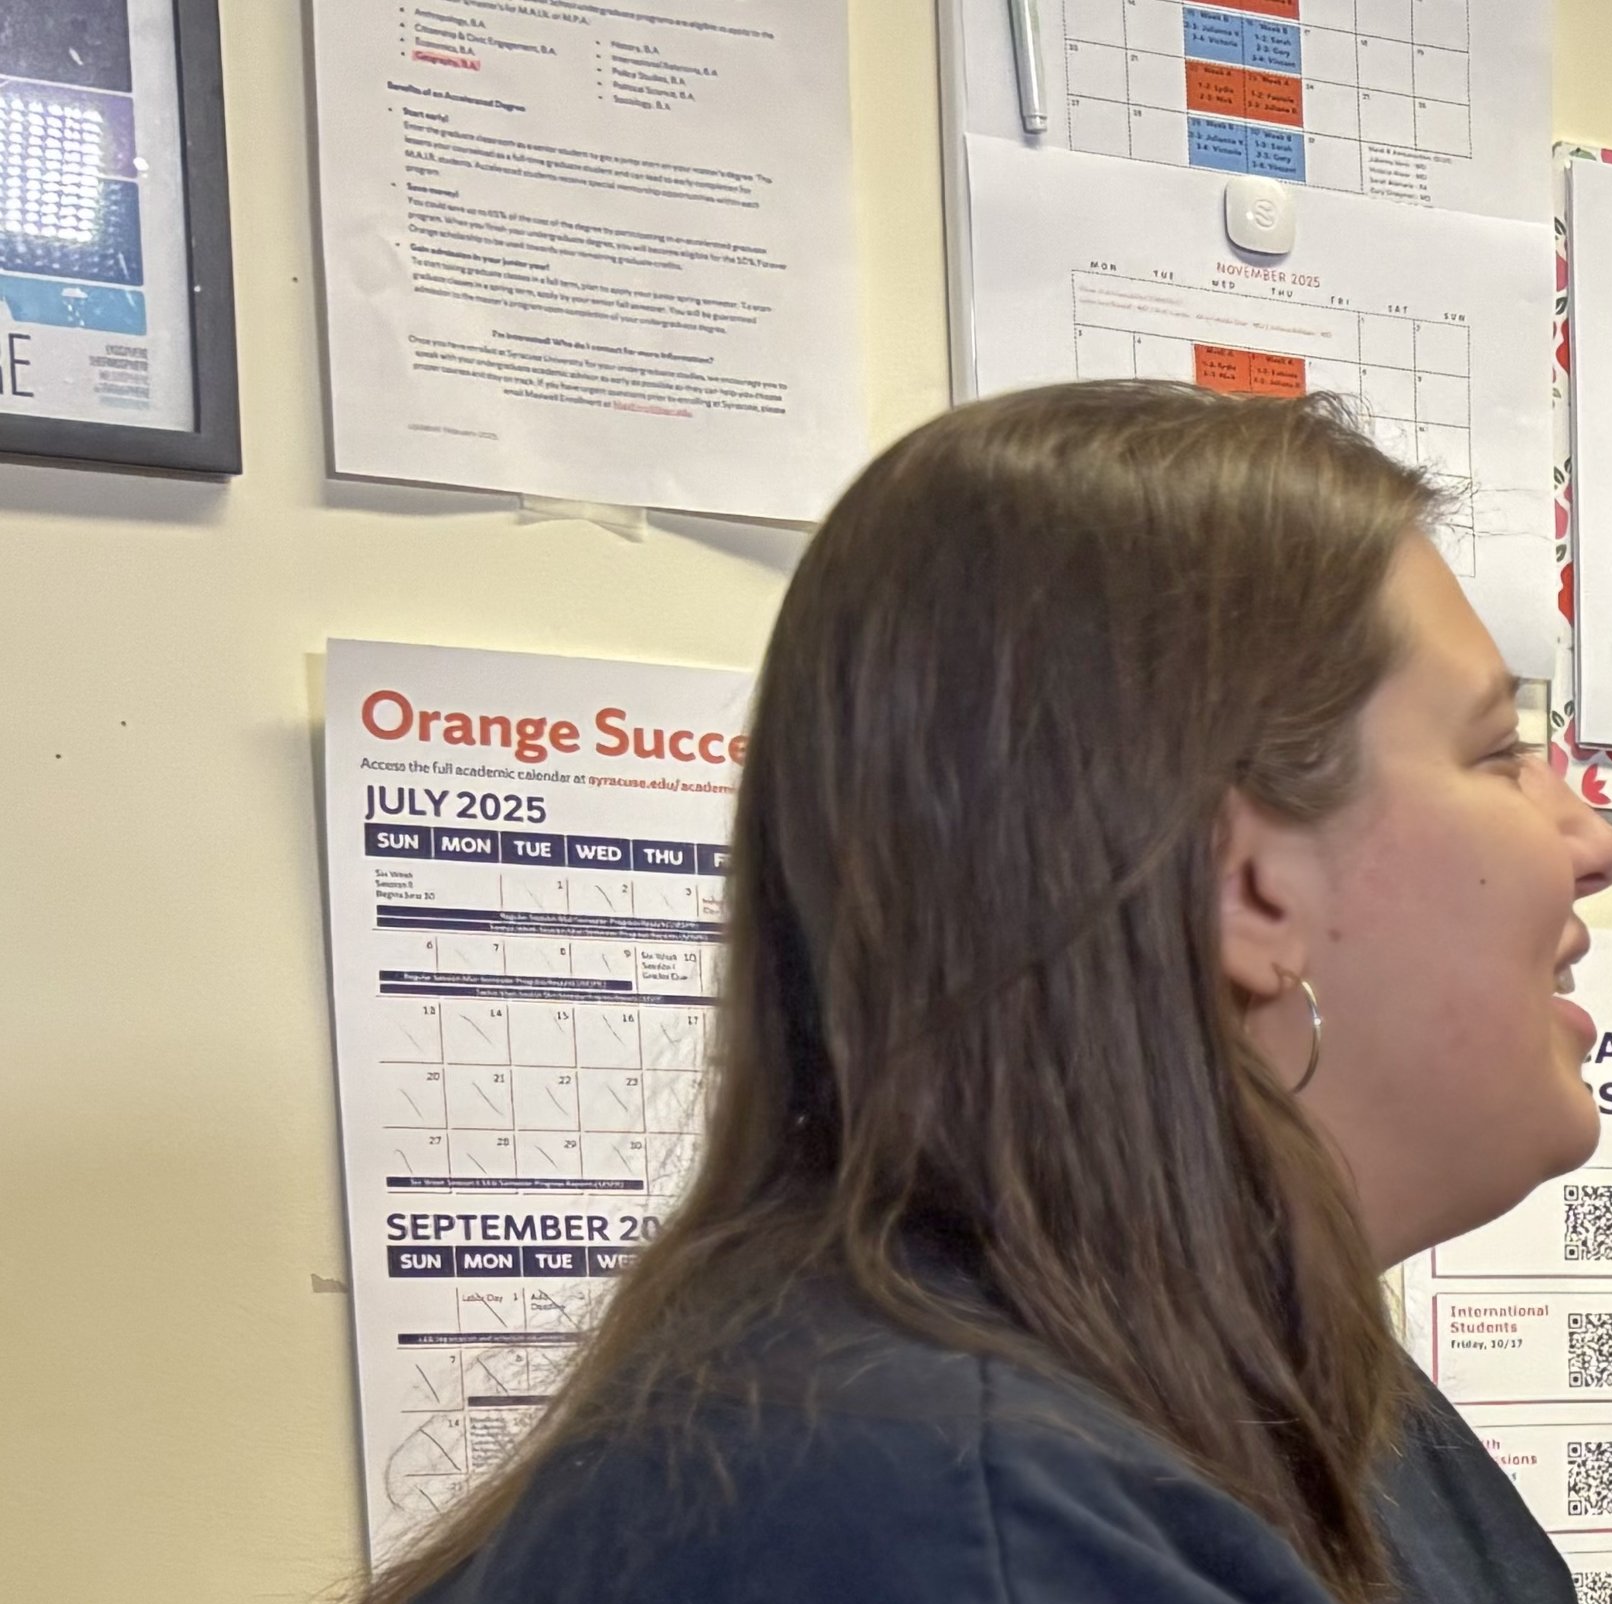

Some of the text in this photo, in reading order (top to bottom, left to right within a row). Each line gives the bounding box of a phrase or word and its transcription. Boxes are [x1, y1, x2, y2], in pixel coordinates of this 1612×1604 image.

[1216, 262, 1321, 288] NOVEMBER 2025
[1090, 261, 1466, 322] MON TUE WED THU FRI SAT SUN
[362, 690, 580, 764] Orange
[361, 757, 586, 785] Access the full academic calendar at
[365, 785, 546, 823] JULY 2025
[377, 832, 684, 865] SUN MON TUE WED THU
[683, 952, 697, 962] 10
[387, 1213, 611, 1242] SEPTEMBER
[400, 1253, 442, 1270] SUN
[464, 1253, 513, 1270] MON
[535, 1253, 573, 1269] TUE
[1450, 1304, 1550, 1319] International
[1450, 1320, 1518, 1334] Students
[1450, 1338, 1523, 1350] Friday, 10/17
